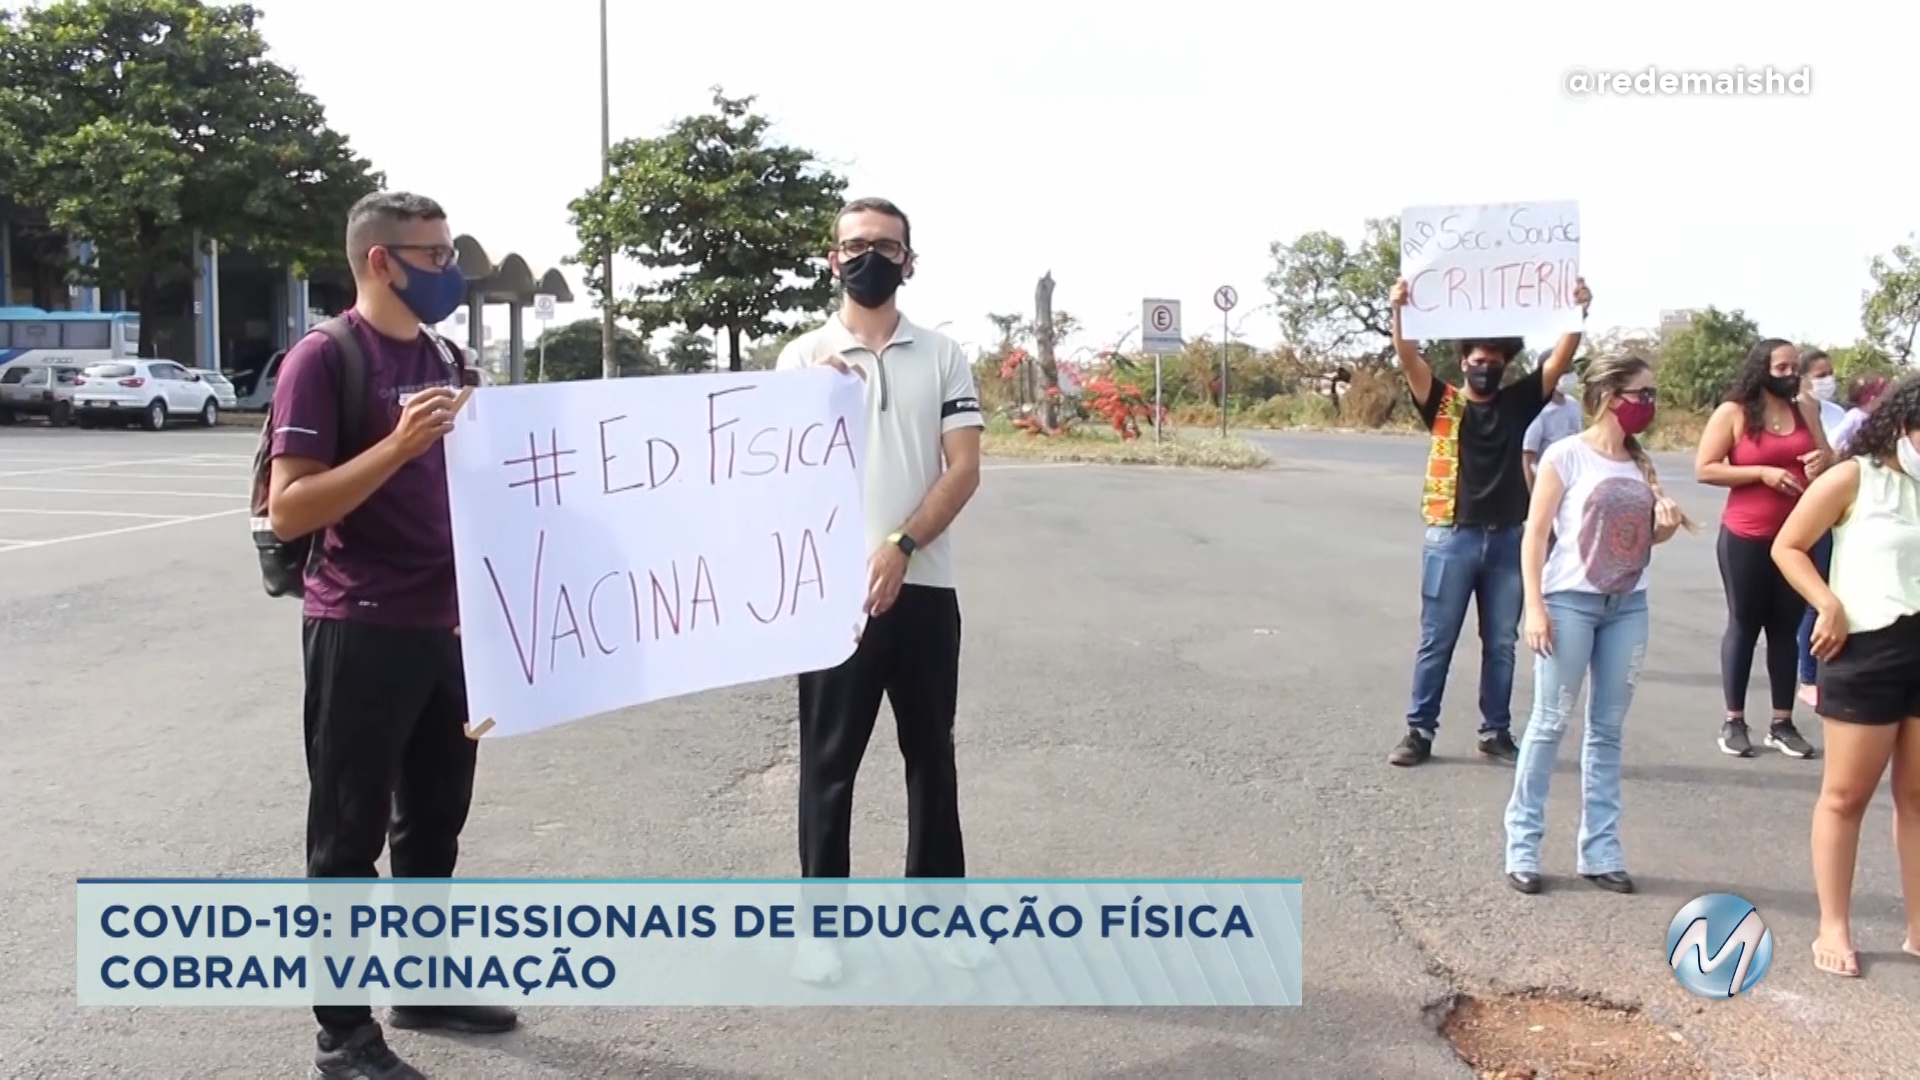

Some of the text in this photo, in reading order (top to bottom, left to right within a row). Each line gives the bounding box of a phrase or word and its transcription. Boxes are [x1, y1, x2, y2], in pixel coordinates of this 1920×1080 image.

[1157, 310, 1168, 327] E
[483, 506, 839, 686] VACINA JÁ
